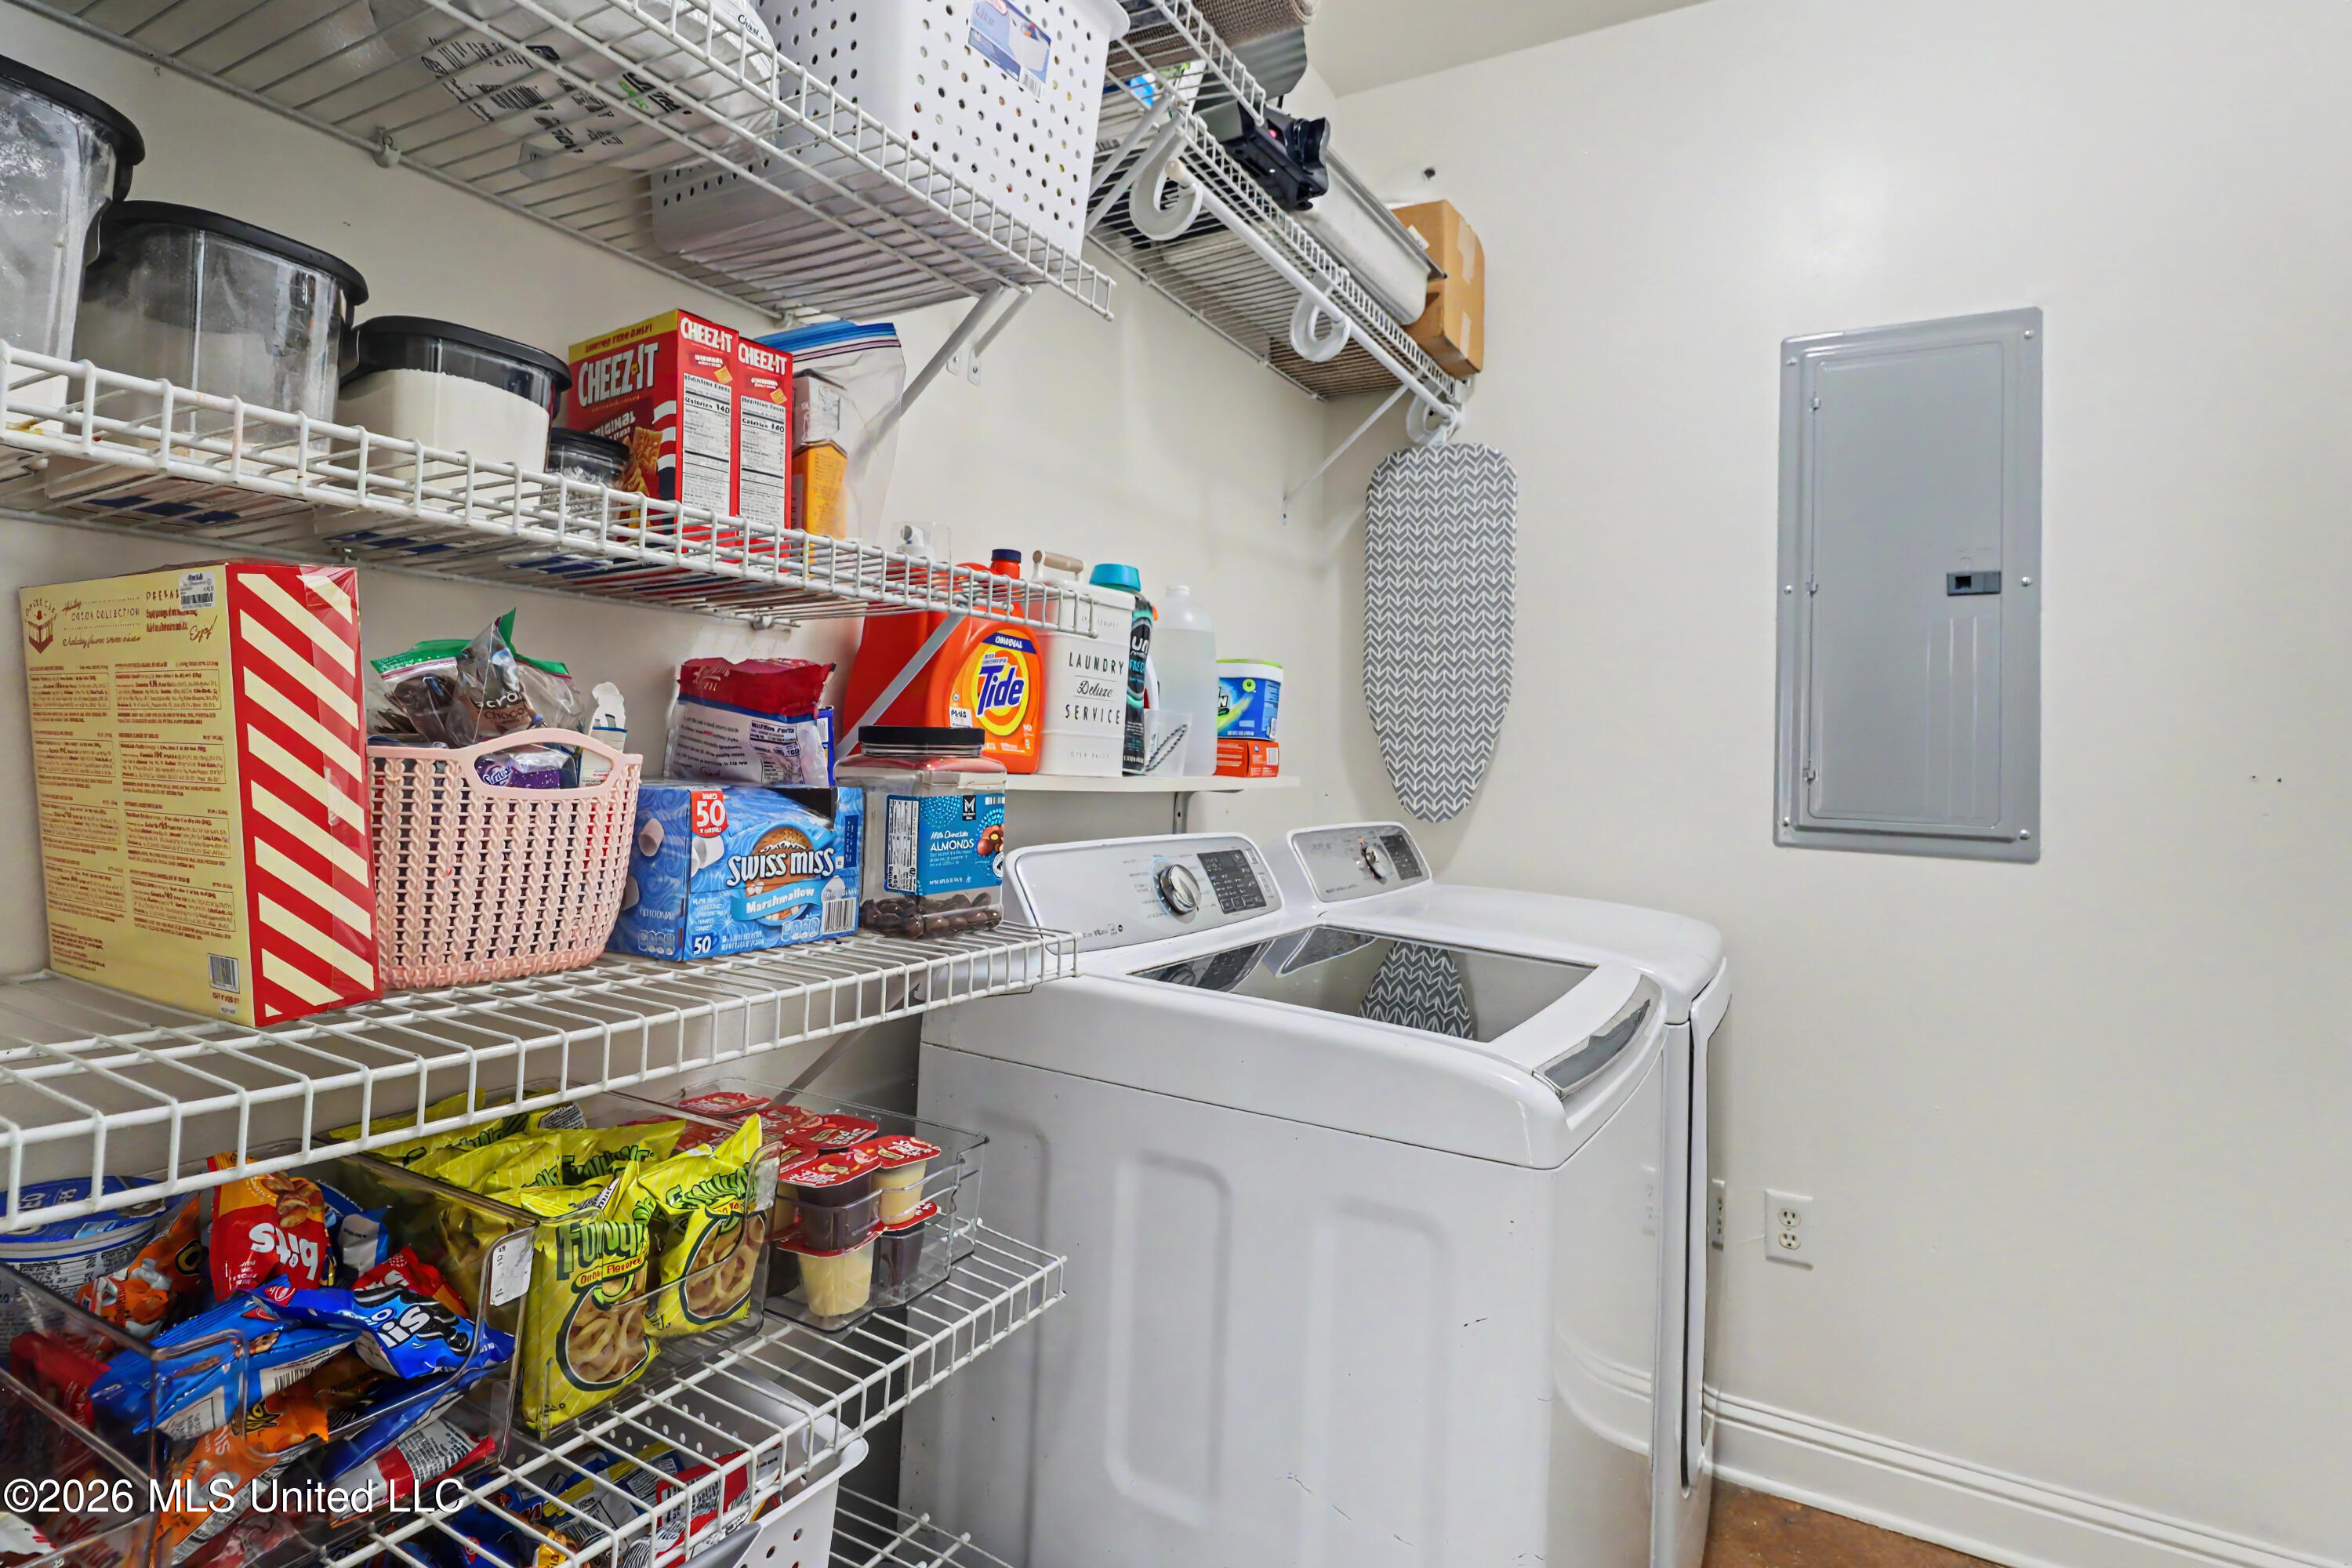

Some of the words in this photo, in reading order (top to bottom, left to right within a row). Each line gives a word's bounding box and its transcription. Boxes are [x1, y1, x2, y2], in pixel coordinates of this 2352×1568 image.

[1069, 652, 1124, 675] LAUNDRY
[977, 665, 1025, 717] Tide
[1065, 704, 1120, 724] SERVICE
[696, 800, 726, 828] 50
[930, 839, 975, 852] ALMONDS
[726, 853, 787, 887] SWISS
[790, 848, 836, 877] MISS
[746, 887, 815, 914] Marshmallow
[693, 935, 712, 955] 50
